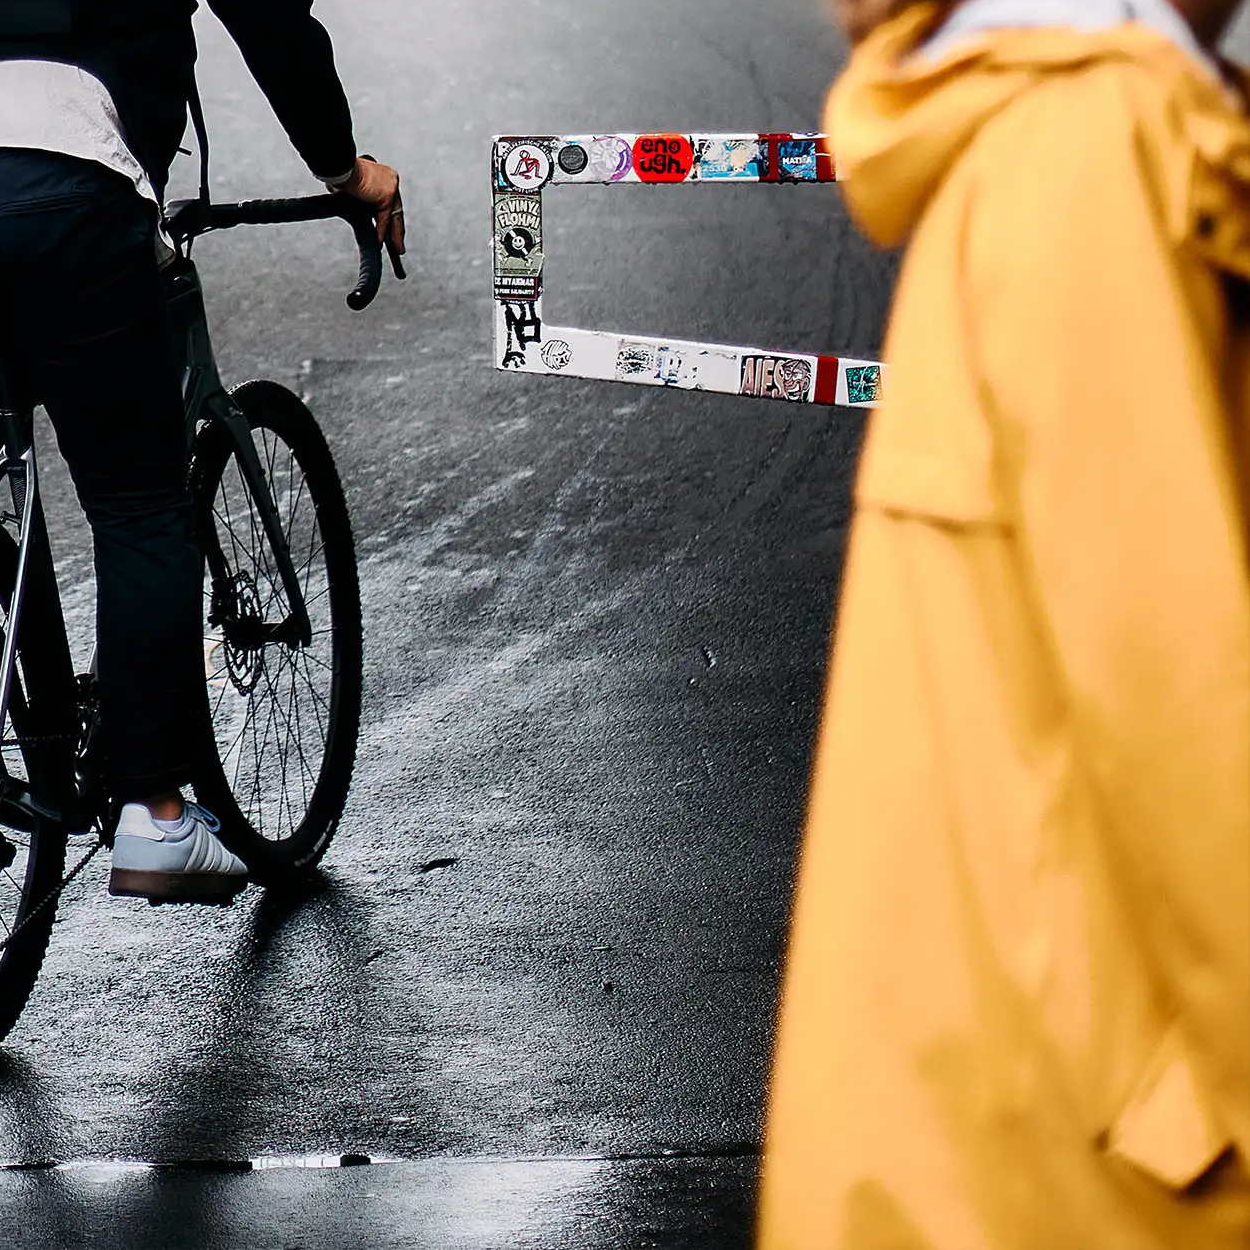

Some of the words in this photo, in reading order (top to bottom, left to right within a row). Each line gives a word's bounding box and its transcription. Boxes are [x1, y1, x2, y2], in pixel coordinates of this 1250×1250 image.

[641, 138, 681, 154] eno
[640, 153, 687, 175] ugh.
[507, 200, 540, 215] VINYL
[498, 213, 540, 230] FLOHMI
